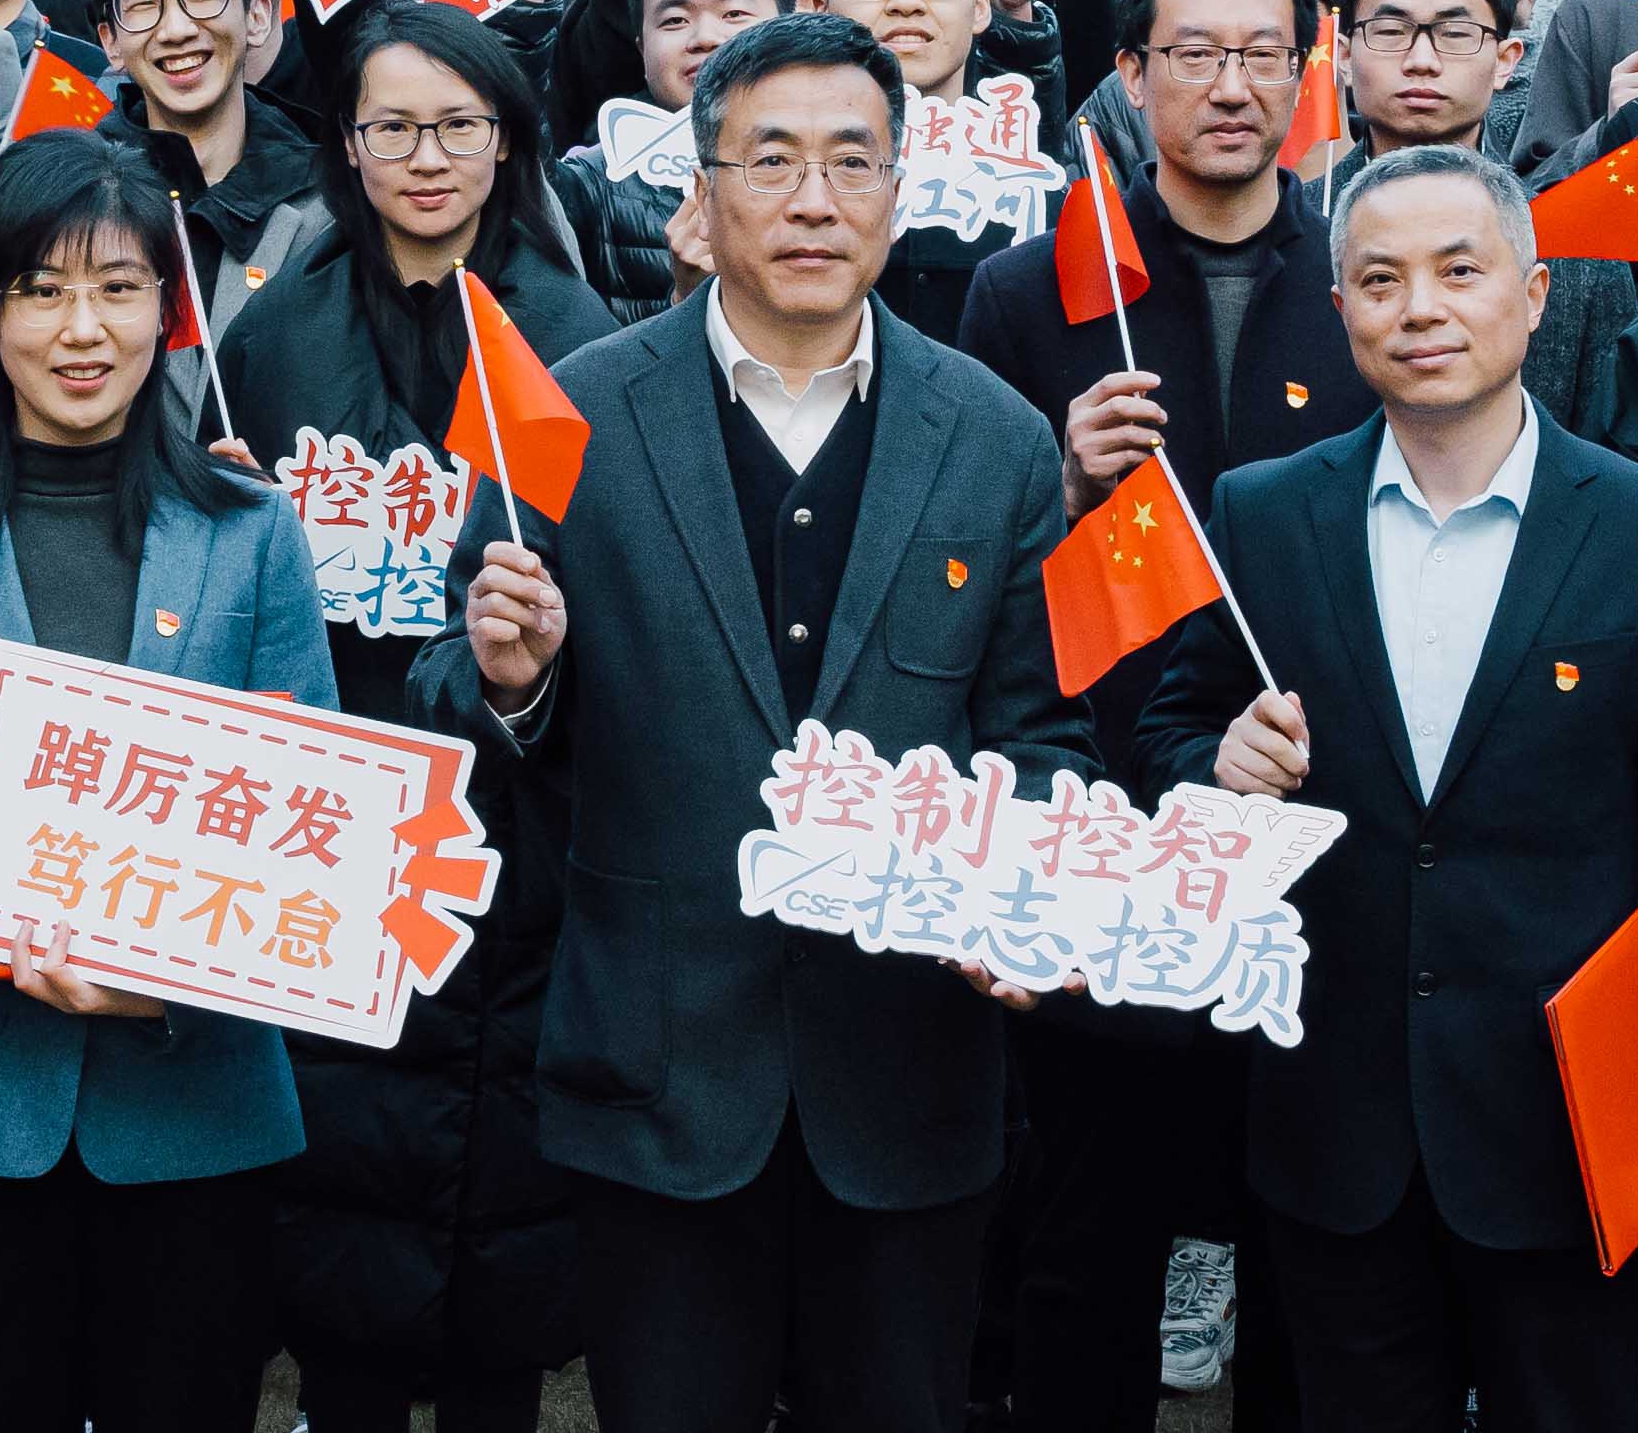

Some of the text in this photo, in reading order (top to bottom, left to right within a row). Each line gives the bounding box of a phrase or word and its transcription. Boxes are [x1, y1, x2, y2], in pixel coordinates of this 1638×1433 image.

[319, 588, 352, 612] SE
[23, 720, 355, 869] 踔厉奋发
[17, 822, 342, 971] 笃行不怠
[785, 888, 848, 922] CSE
